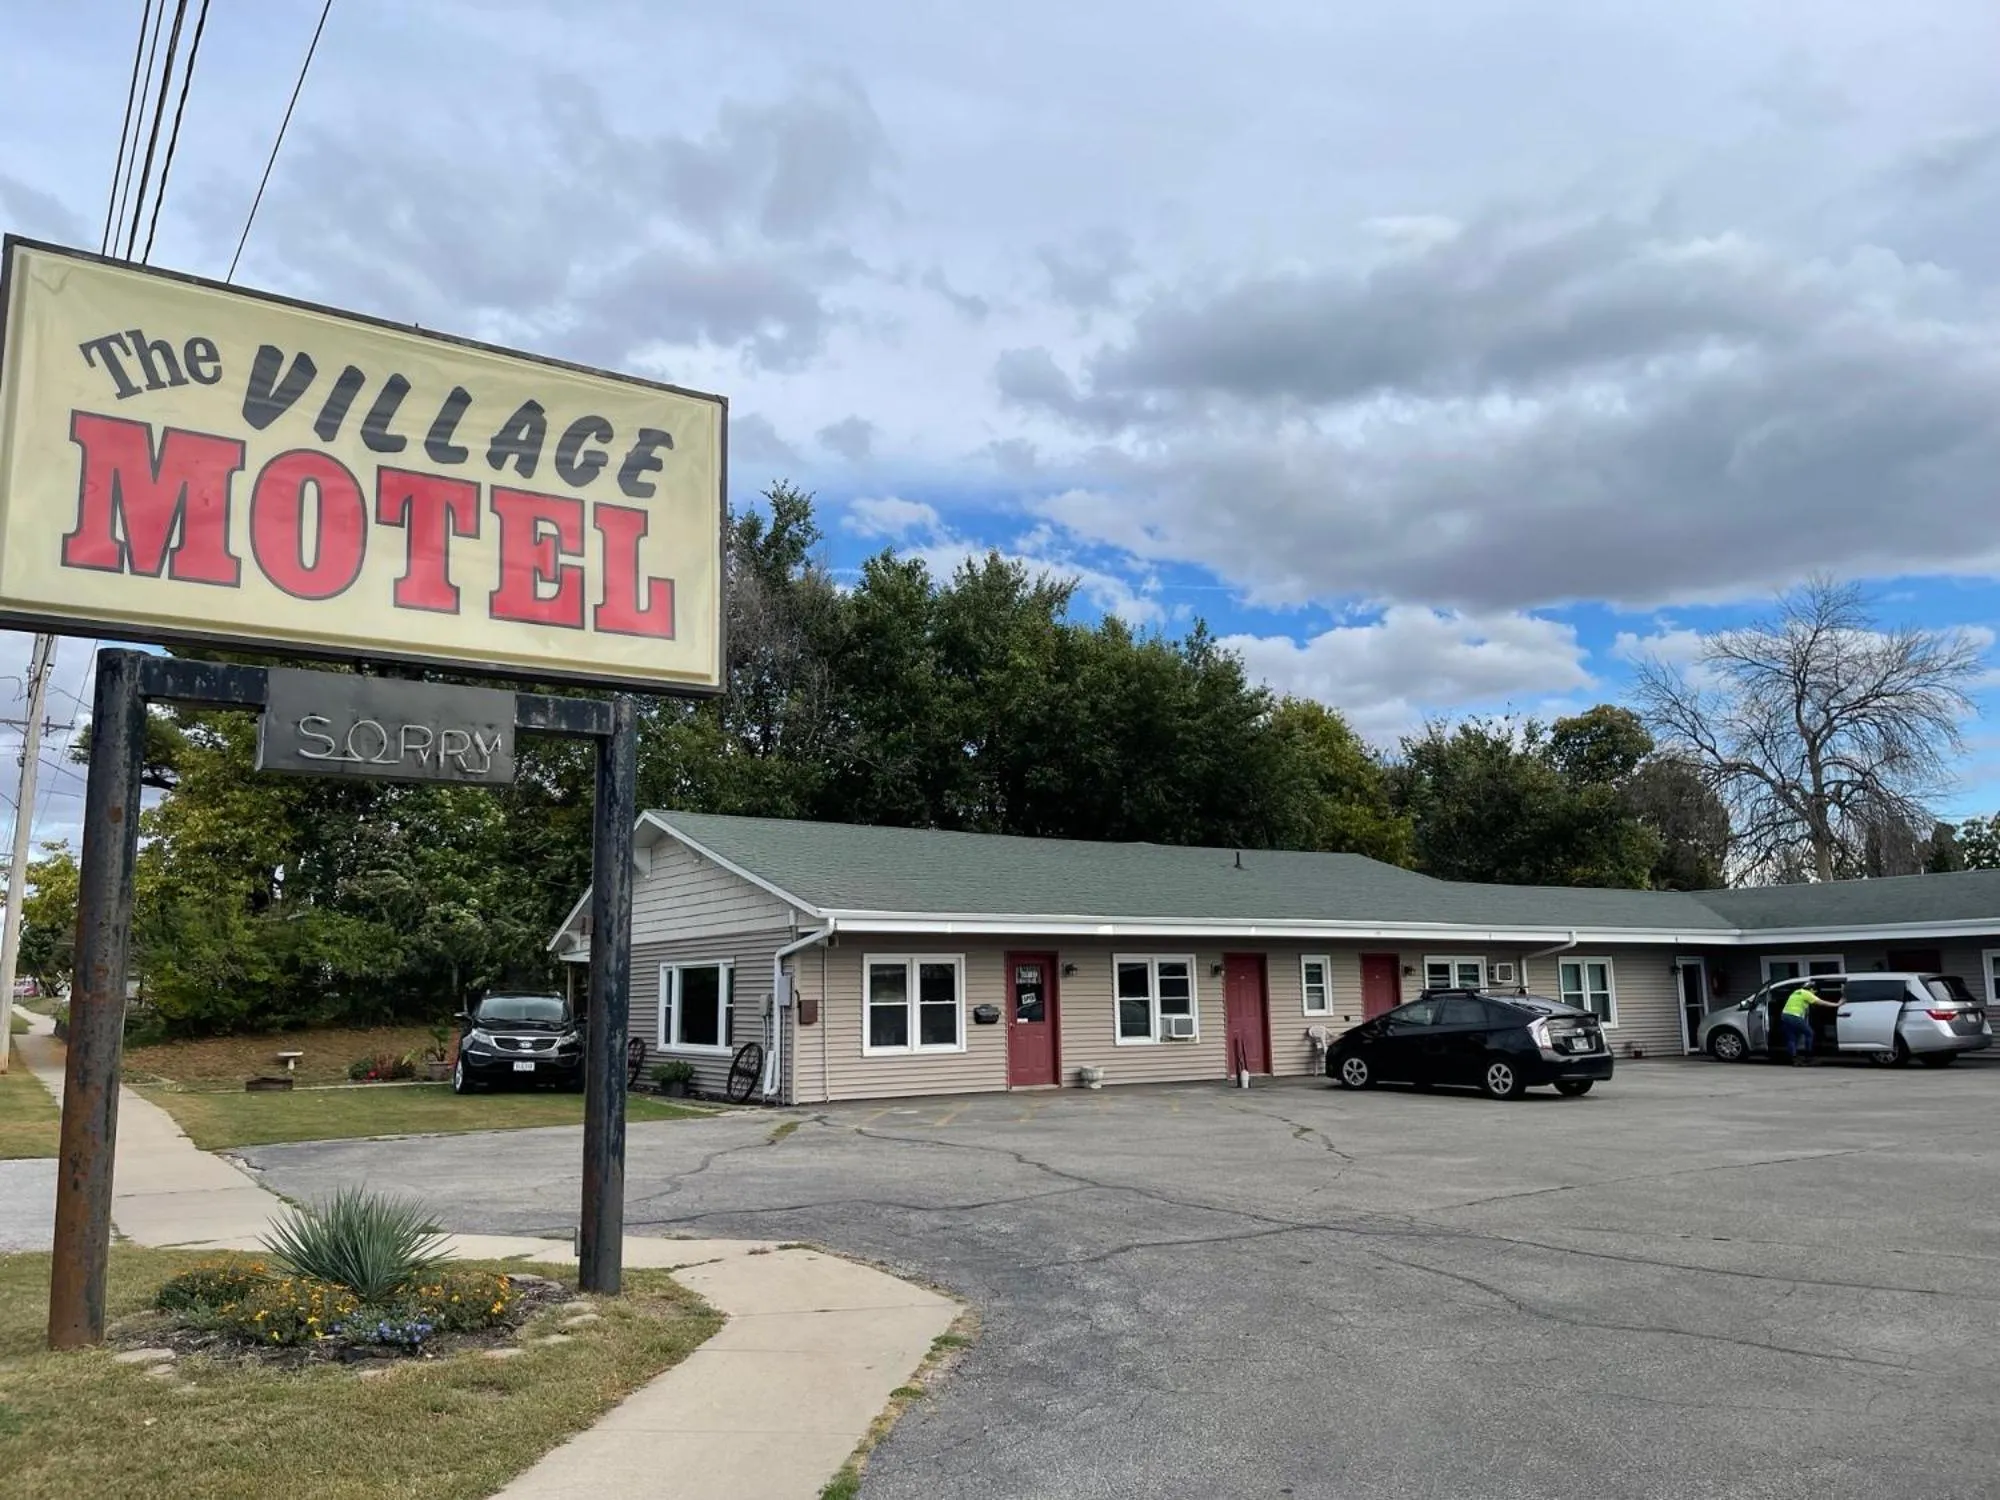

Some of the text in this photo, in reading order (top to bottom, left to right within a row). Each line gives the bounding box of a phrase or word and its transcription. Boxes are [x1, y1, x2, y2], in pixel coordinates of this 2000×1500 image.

[79, 329, 673, 498] The VILLAGE
[61, 409, 676, 641] MOTEL
[299, 715, 502, 774] SORRY
